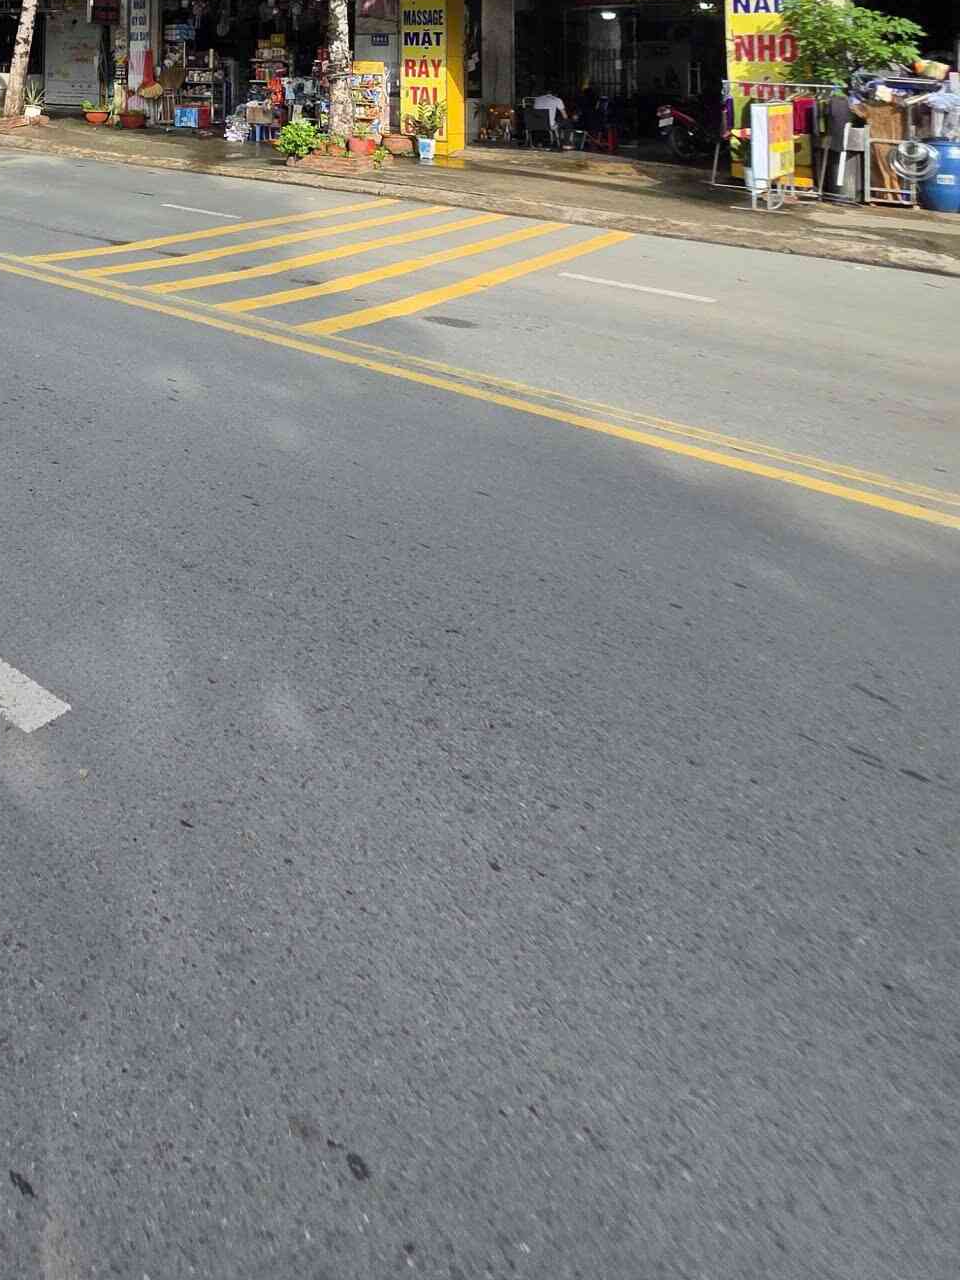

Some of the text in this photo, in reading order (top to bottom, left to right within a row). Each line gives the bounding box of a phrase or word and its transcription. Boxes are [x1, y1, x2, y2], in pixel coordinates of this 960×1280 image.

[403, 8, 444, 26] MASSAGE
[403, 28, 444, 49] MẶT
[404, 55, 443, 78] RÁY
[409, 86, 439, 106] TAI
